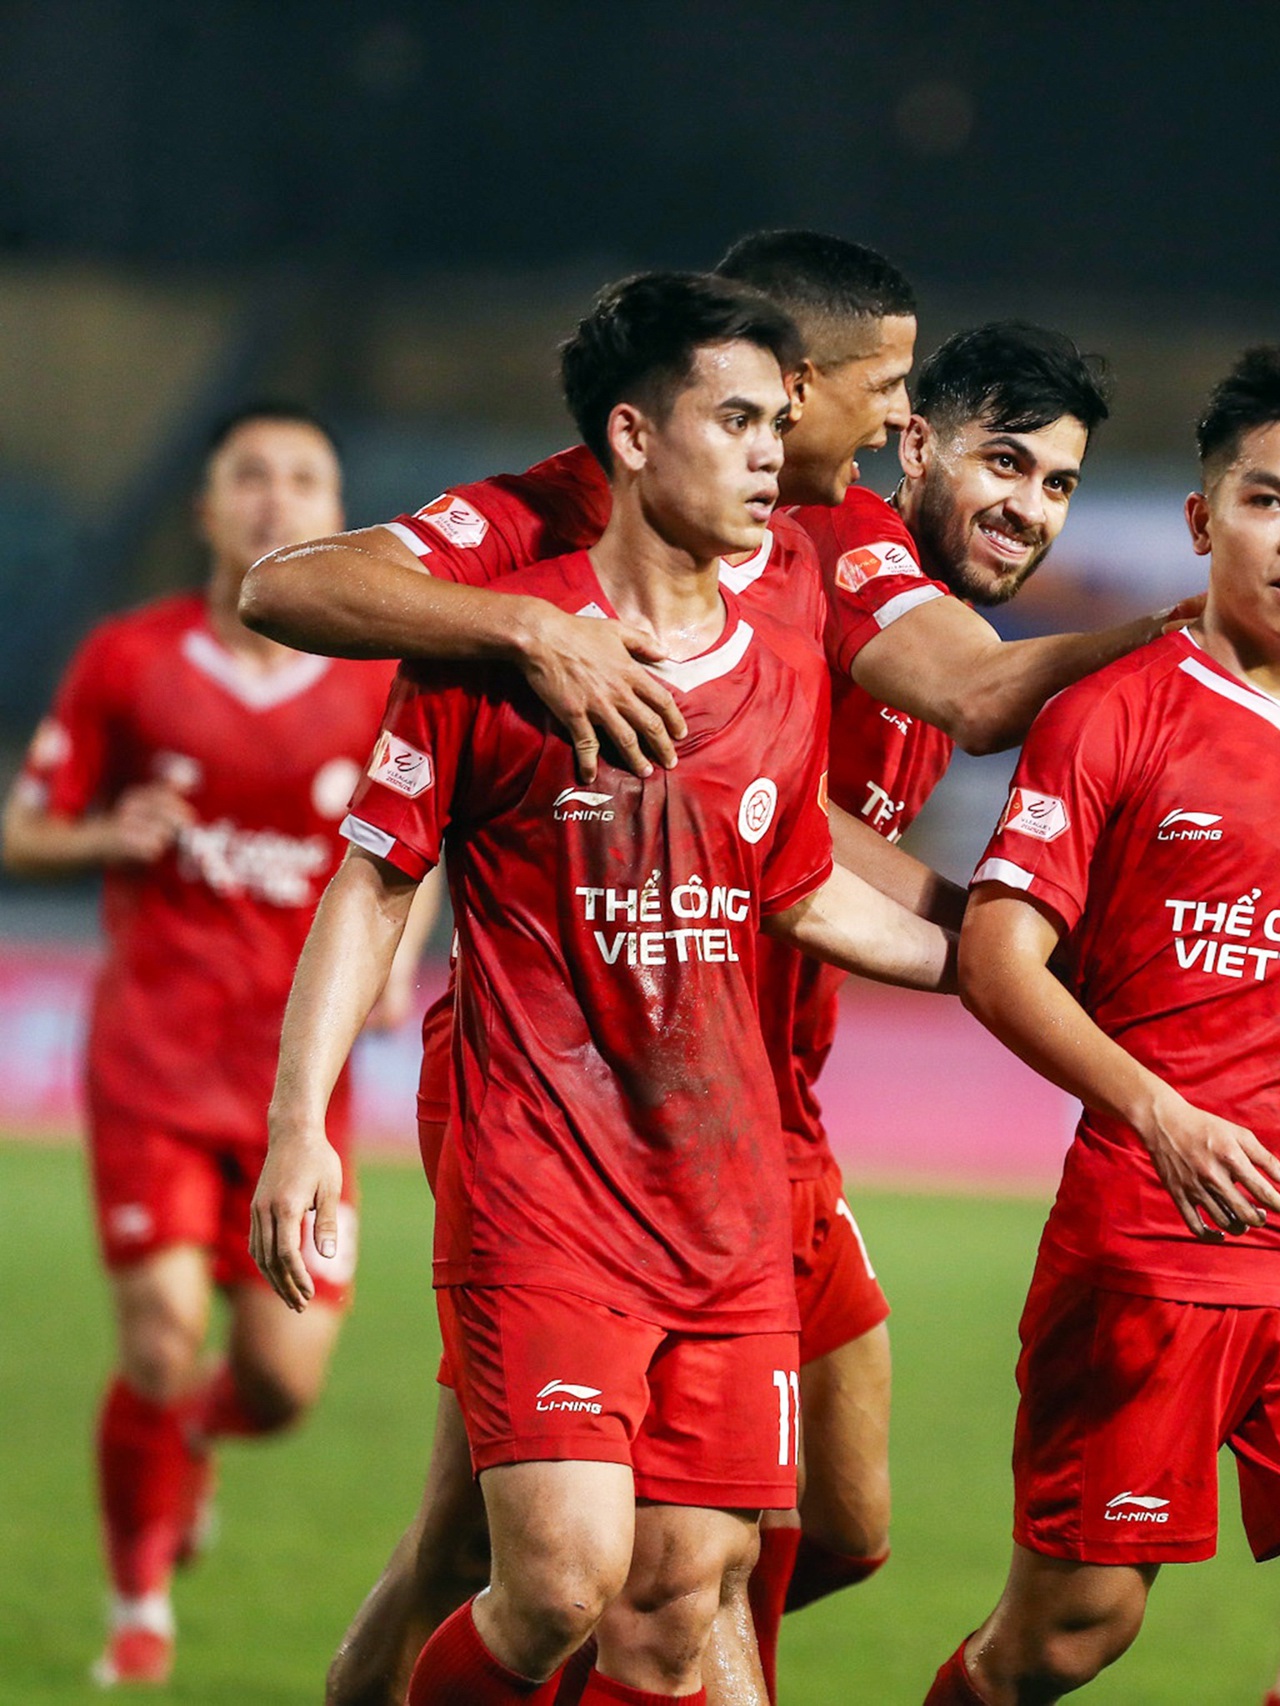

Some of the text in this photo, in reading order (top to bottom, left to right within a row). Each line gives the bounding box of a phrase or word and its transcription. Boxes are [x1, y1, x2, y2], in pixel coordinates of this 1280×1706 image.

[553, 810, 615, 822] LI-NING
[1157, 829, 1222, 842] LI-NING
[575, 869, 662, 922] THỂ
[1164, 888, 1261, 938] THỂ
[594, 928, 739, 966] VIETTEL
[536, 1400, 602, 1415] LI-NING
[773, 1370, 800, 1466] 11
[1105, 1510, 1169, 1523] LI-NING
